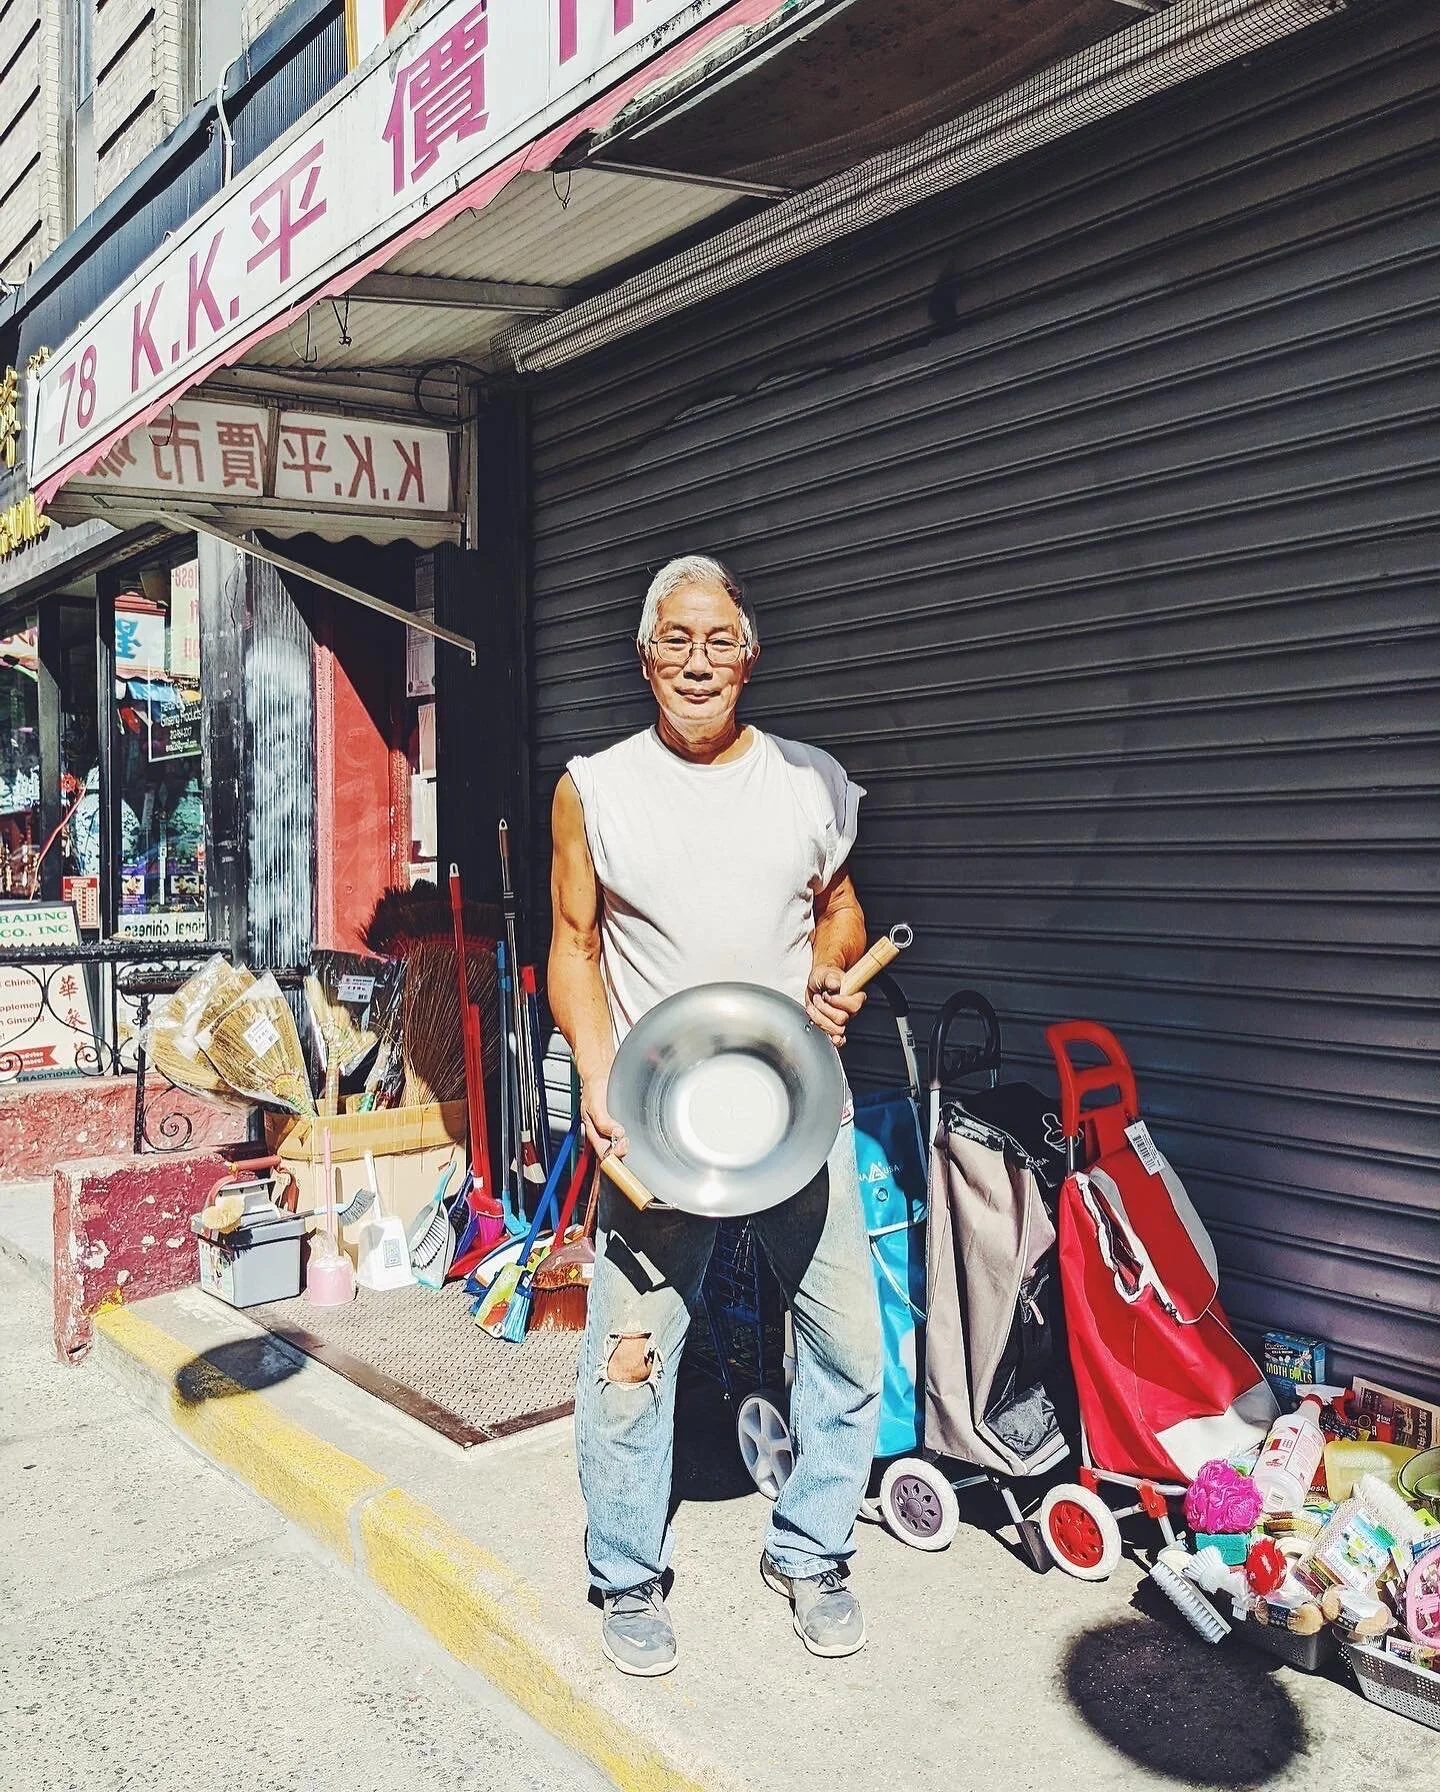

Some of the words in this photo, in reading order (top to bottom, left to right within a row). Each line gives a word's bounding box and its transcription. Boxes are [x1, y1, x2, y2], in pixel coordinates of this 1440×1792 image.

[57, 344, 98, 446] 78
[131, 230, 241, 394] K.K.
[4, 978, 36, 988] Chines
[1265, 1362, 1288, 1378] MOTH
